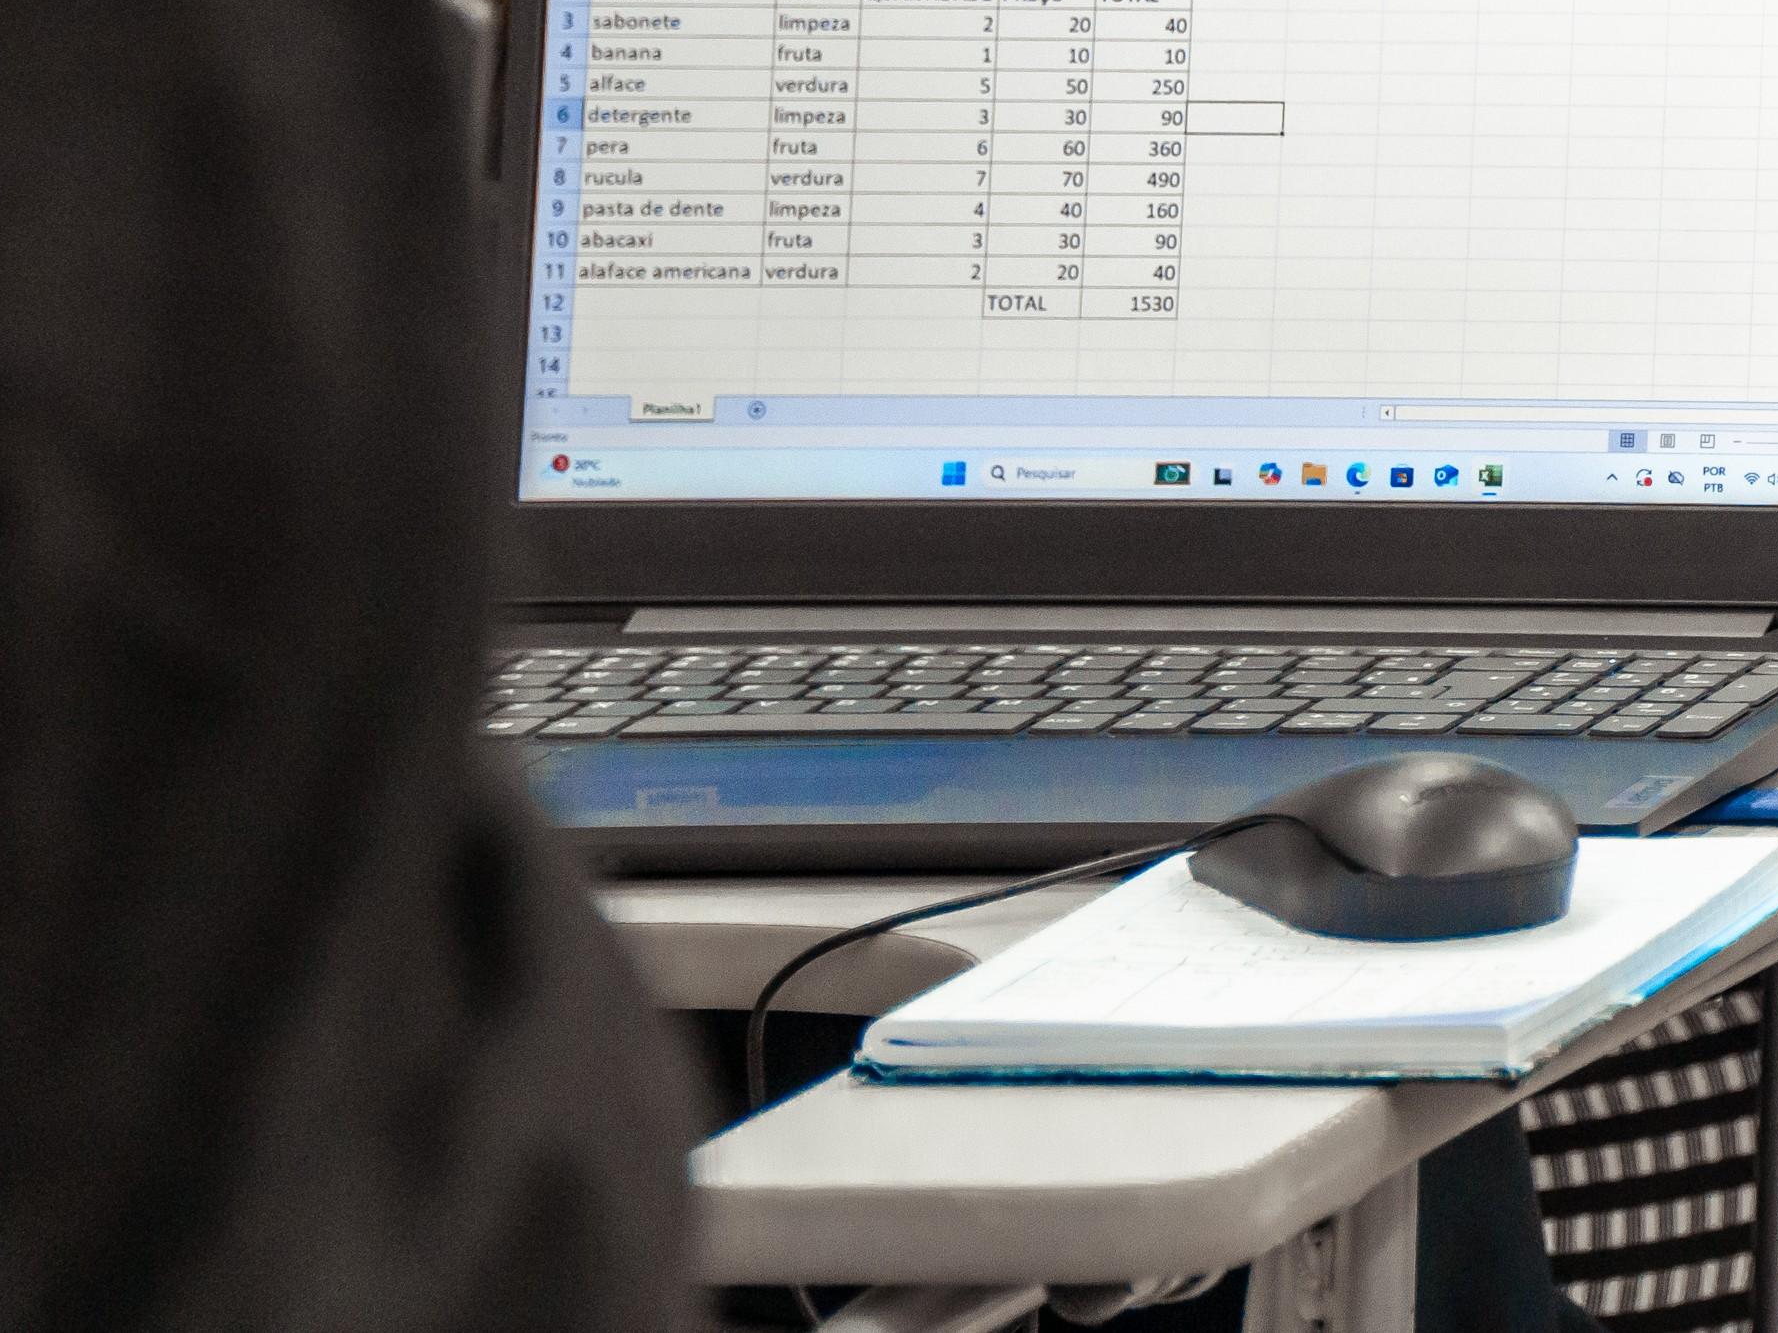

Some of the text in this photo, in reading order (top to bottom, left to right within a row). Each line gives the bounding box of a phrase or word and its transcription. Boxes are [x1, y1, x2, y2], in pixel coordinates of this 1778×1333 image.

[562, 13, 574, 29] 3
[592, 14, 681, 31] sabonete
[779, 15, 851, 34] limpeza
[983, 16, 993, 33] 2
[1069, 17, 1091, 33] 20
[1165, 17, 1187, 34] 40
[560, 44, 572, 60] 4
[591, 45, 662, 62] banana
[778, 45, 823, 62] fruta
[983, 48, 991, 63] 1
[1069, 48, 1090, 65] 10
[1165, 48, 1186, 65] 10
[559, 74, 571, 92] 5
[589, 75, 646, 93] alface
[775, 76, 848, 94] verdura
[980, 78, 991, 95] 5
[1066, 78, 1089, 95] 50
[1152, 79, 1185, 96] 250
[557, 106, 569, 123] 6
[588, 106, 693, 126] detergente
[773, 106, 846, 127] limpeza
[979, 109, 990, 126] 3
[1065, 110, 1087, 126] 30
[1161, 110, 1183, 126] 90
[556, 137, 568, 154] 7
[586, 140, 629, 157] pera
[772, 138, 818, 155] fruta
[977, 140, 988, 156] 6
[1063, 140, 1086, 157] 60
[1149, 141, 1182, 157] 360
[554, 168, 566, 185] 8
[584, 169, 643, 185] rucula
[771, 169, 844, 187] verdura
[975, 170, 987, 188] 7
[1062, 171, 1084, 188] 70
[1147, 171, 1181, 188] 490
[552, 199, 564, 217] 9
[582, 199, 724, 220] pasta de dente
[769, 200, 841, 220] limpeza
[974, 202, 984, 218] 4
[1060, 202, 1083, 219] 40
[1146, 203, 1179, 219] 160
[548, 232, 569, 248] 10
[580, 231, 653, 249] abacaxi
[767, 232, 813, 249] fruta
[971, 232, 983, 249] 3
[1058, 233, 1081, 250] 30
[1155, 233, 1177, 250] 90
[546, 264, 565, 280] 11
[579, 263, 751, 280] alaface americana
[765, 264, 839, 281] verdura
[970, 264, 981, 281] 2
[1057, 264, 1079, 281] 20
[1153, 265, 1175, 281] 40
[544, 294, 563, 311] 12
[987, 295, 1047, 312] TOTAL
[1130, 296, 1174, 313] 1530
[541, 325, 562, 343] 13
[539, 357, 560, 375] 14
[642, 402, 702, 416] Planilha1
[1016, 467, 1076, 481] Pesquisar
[1703, 467, 1726, 477] POR
[1704, 484, 1724, 494] PTB
